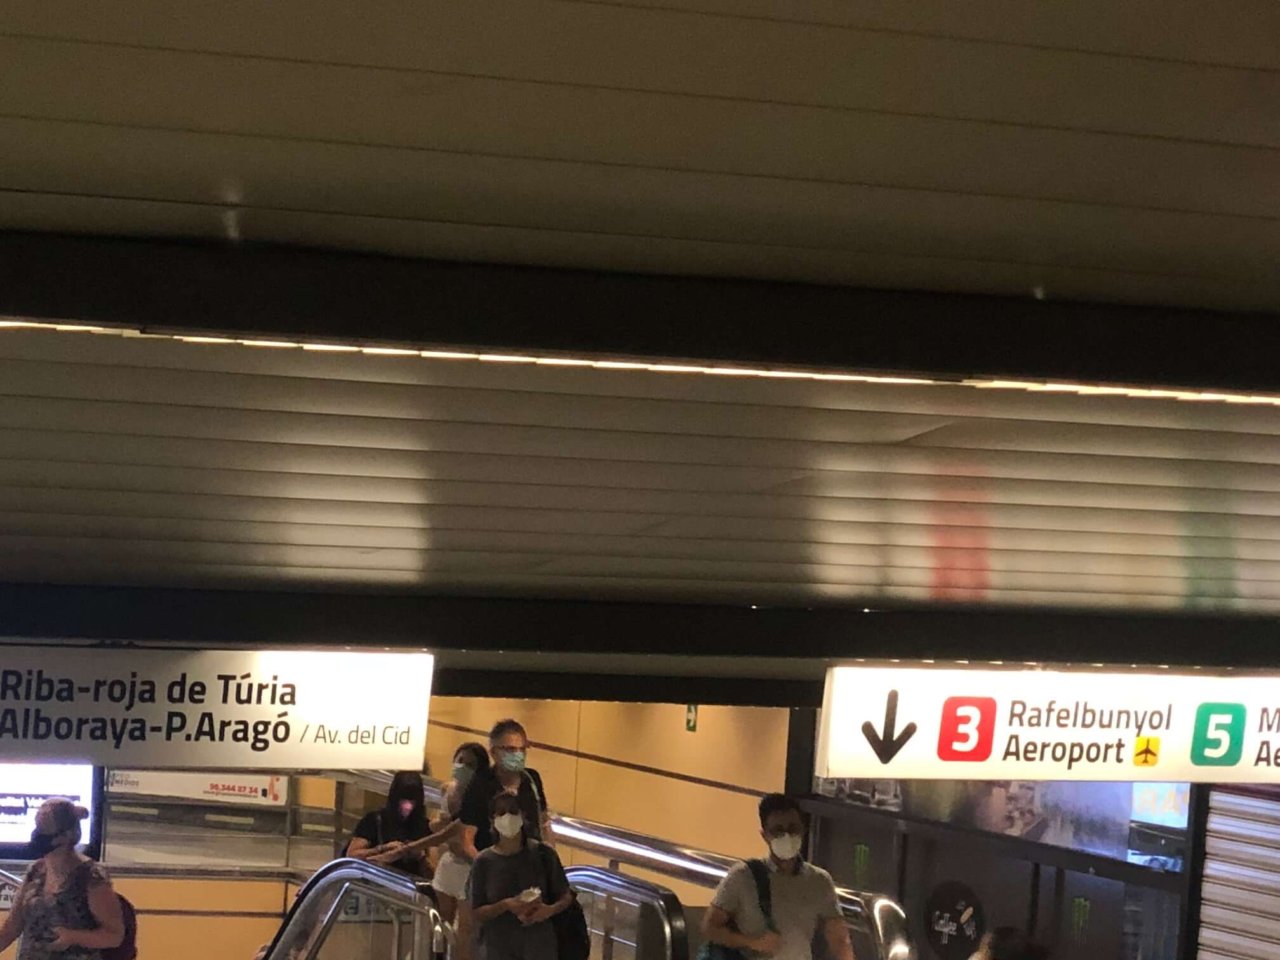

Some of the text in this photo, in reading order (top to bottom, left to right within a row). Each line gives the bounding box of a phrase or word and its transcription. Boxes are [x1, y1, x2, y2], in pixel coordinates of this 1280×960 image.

[0, 669, 296, 711] Riba-roja de Túria
[314, 724, 342, 744] Av.
[348, 725, 376, 745] del
[382, 725, 411, 745] Cid
[951, 706, 981, 752] 3
[1008, 700, 1172, 737] Rafelbunyol
[1203, 714, 1233, 758] 5
[1002, 734, 1125, 770] Aeroport
